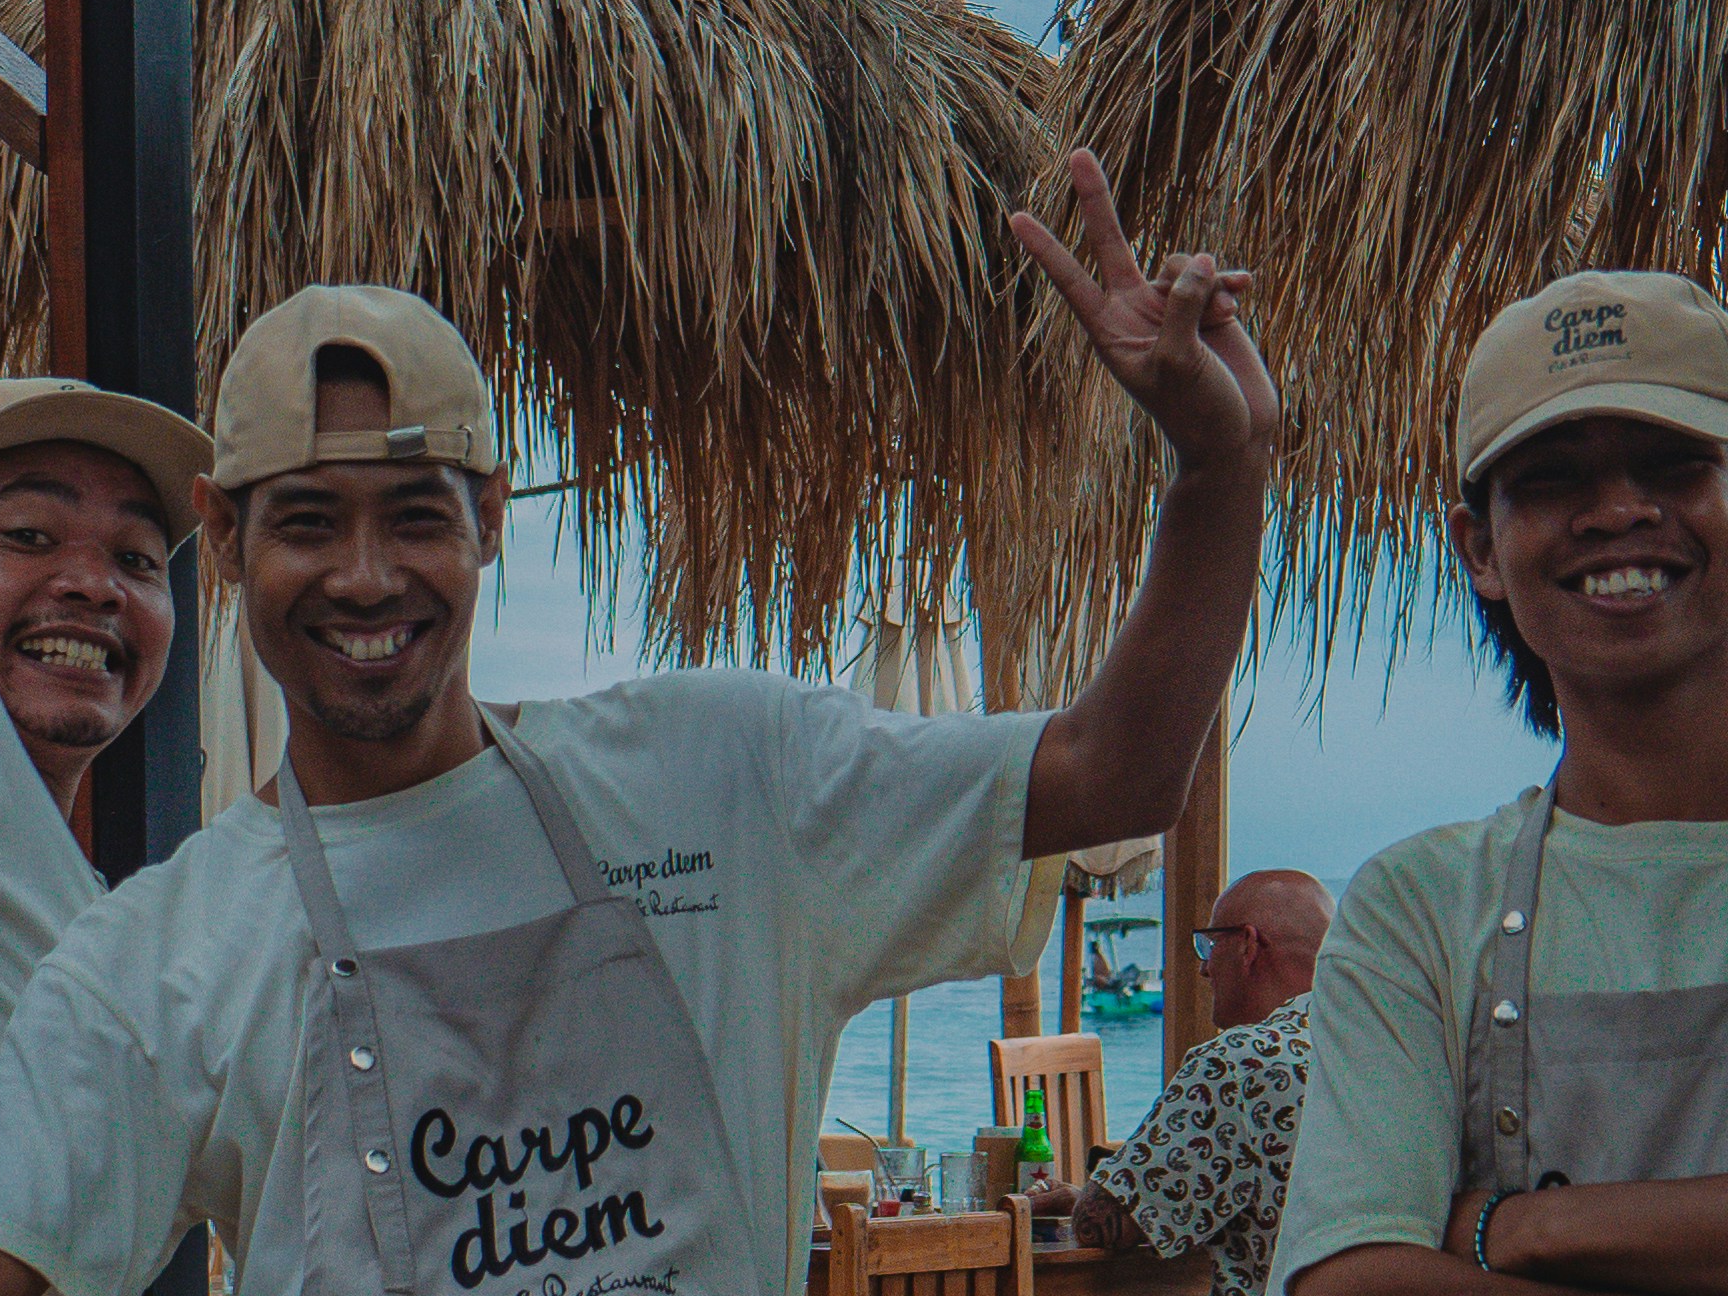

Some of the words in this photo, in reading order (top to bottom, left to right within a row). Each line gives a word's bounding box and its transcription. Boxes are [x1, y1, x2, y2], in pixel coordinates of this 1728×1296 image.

[1544, 303, 1629, 333] Carpe
[1552, 325, 1629, 357] diem
[661, 848, 715, 879] diem
[410, 1094, 656, 1199] Carpe
[451, 1190, 666, 1290] diem
